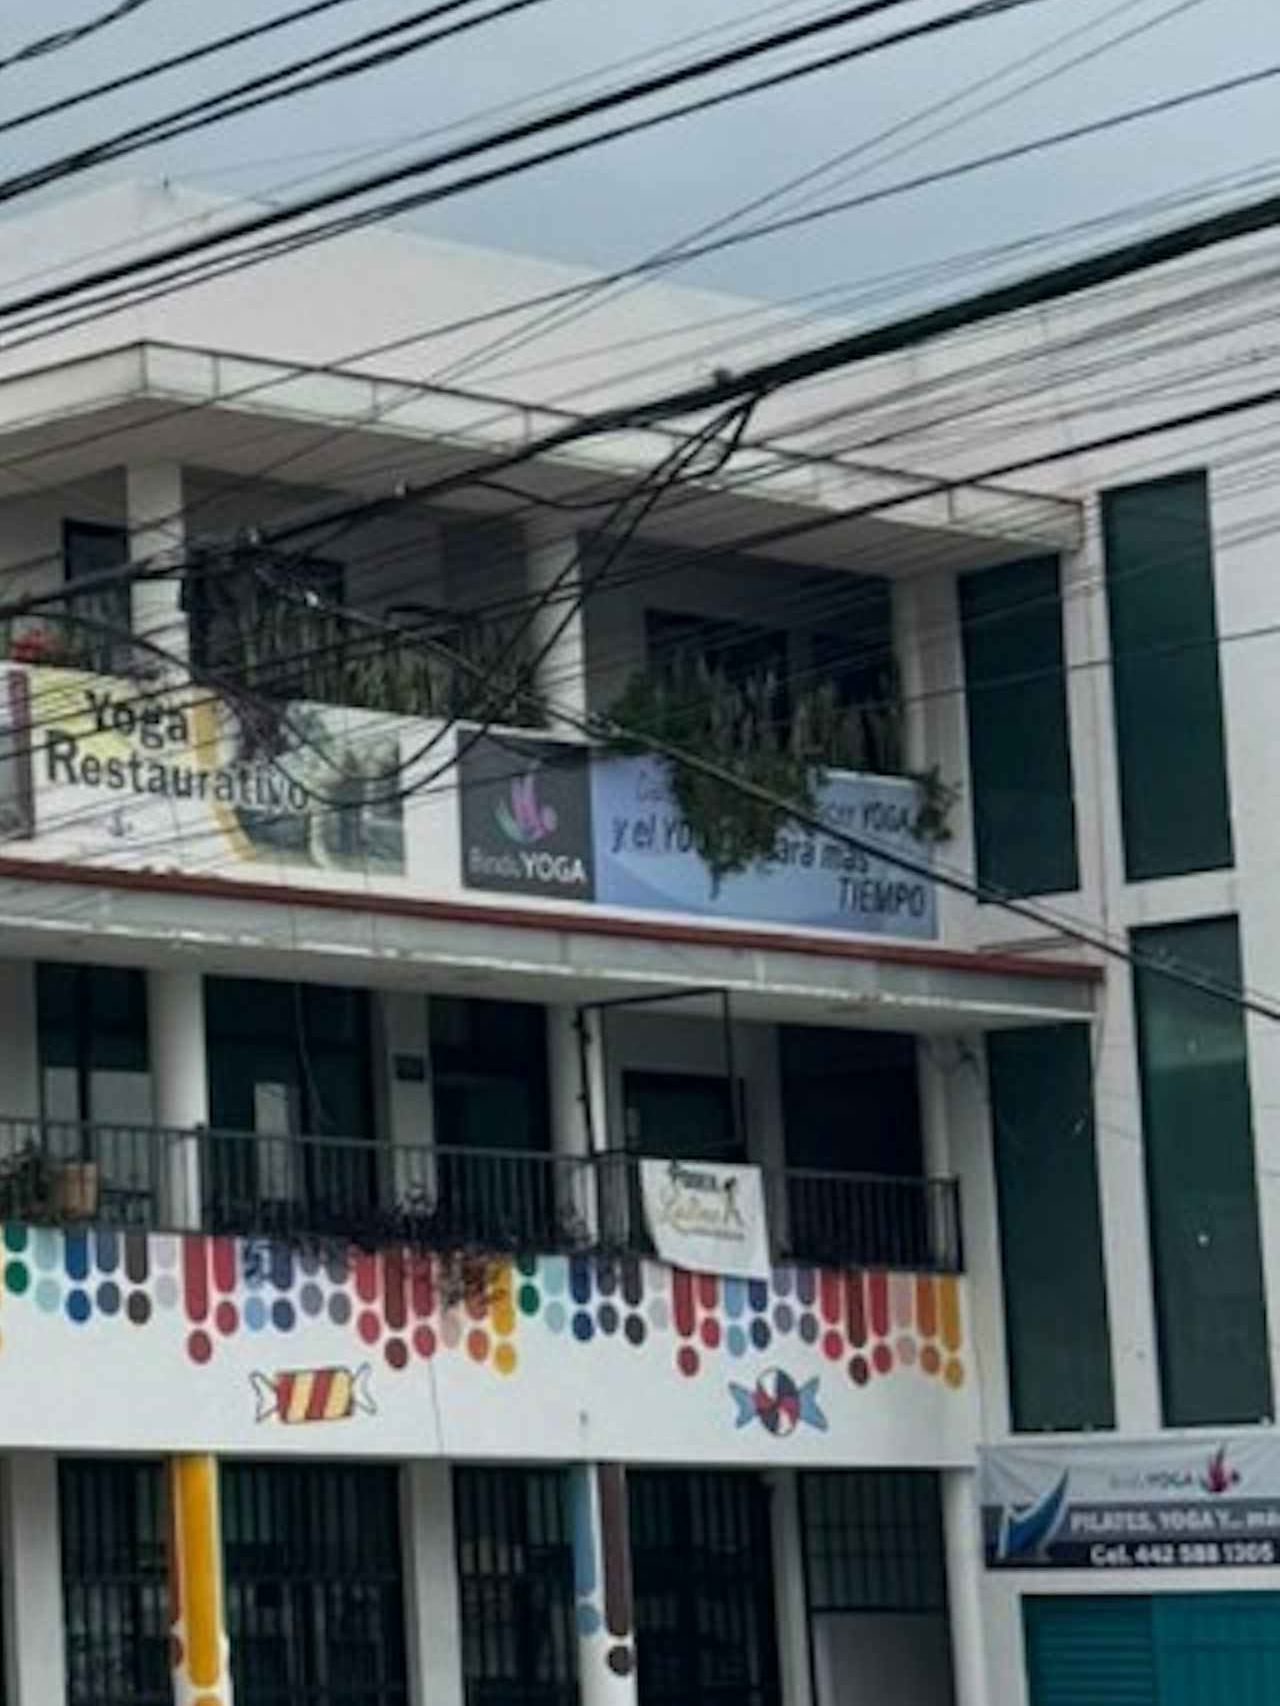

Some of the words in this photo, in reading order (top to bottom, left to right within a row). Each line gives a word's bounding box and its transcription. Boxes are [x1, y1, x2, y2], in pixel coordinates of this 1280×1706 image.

[83, 688, 187, 748] Yoga
[46, 729, 309, 815] Restaurativo
[610, 816, 629, 854] y
[631, 812, 656, 848] el
[519, 850, 585, 885] YOGA
[838, 874, 926, 918] TIEMPO
[1158, 1509, 1215, 1531] YOGA
[1135, 1545, 1175, 1564] 442
